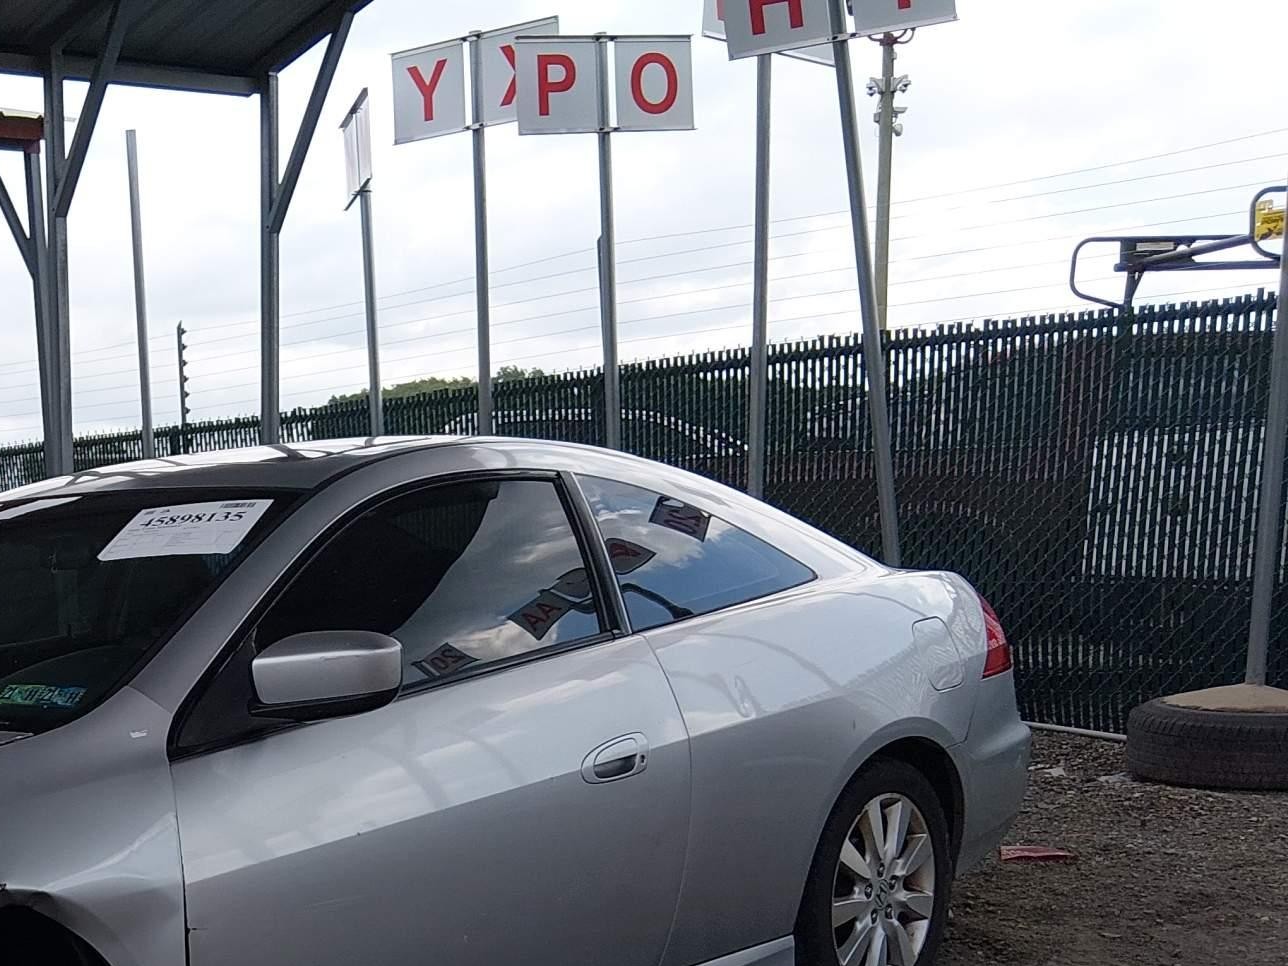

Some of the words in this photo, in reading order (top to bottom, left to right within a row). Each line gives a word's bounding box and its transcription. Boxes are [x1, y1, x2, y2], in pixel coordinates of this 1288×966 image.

[406, 59, 448, 122] Y
[537, 54, 576, 116] P
[630, 52, 678, 115] O
[140, 511, 248, 527] 45898135
